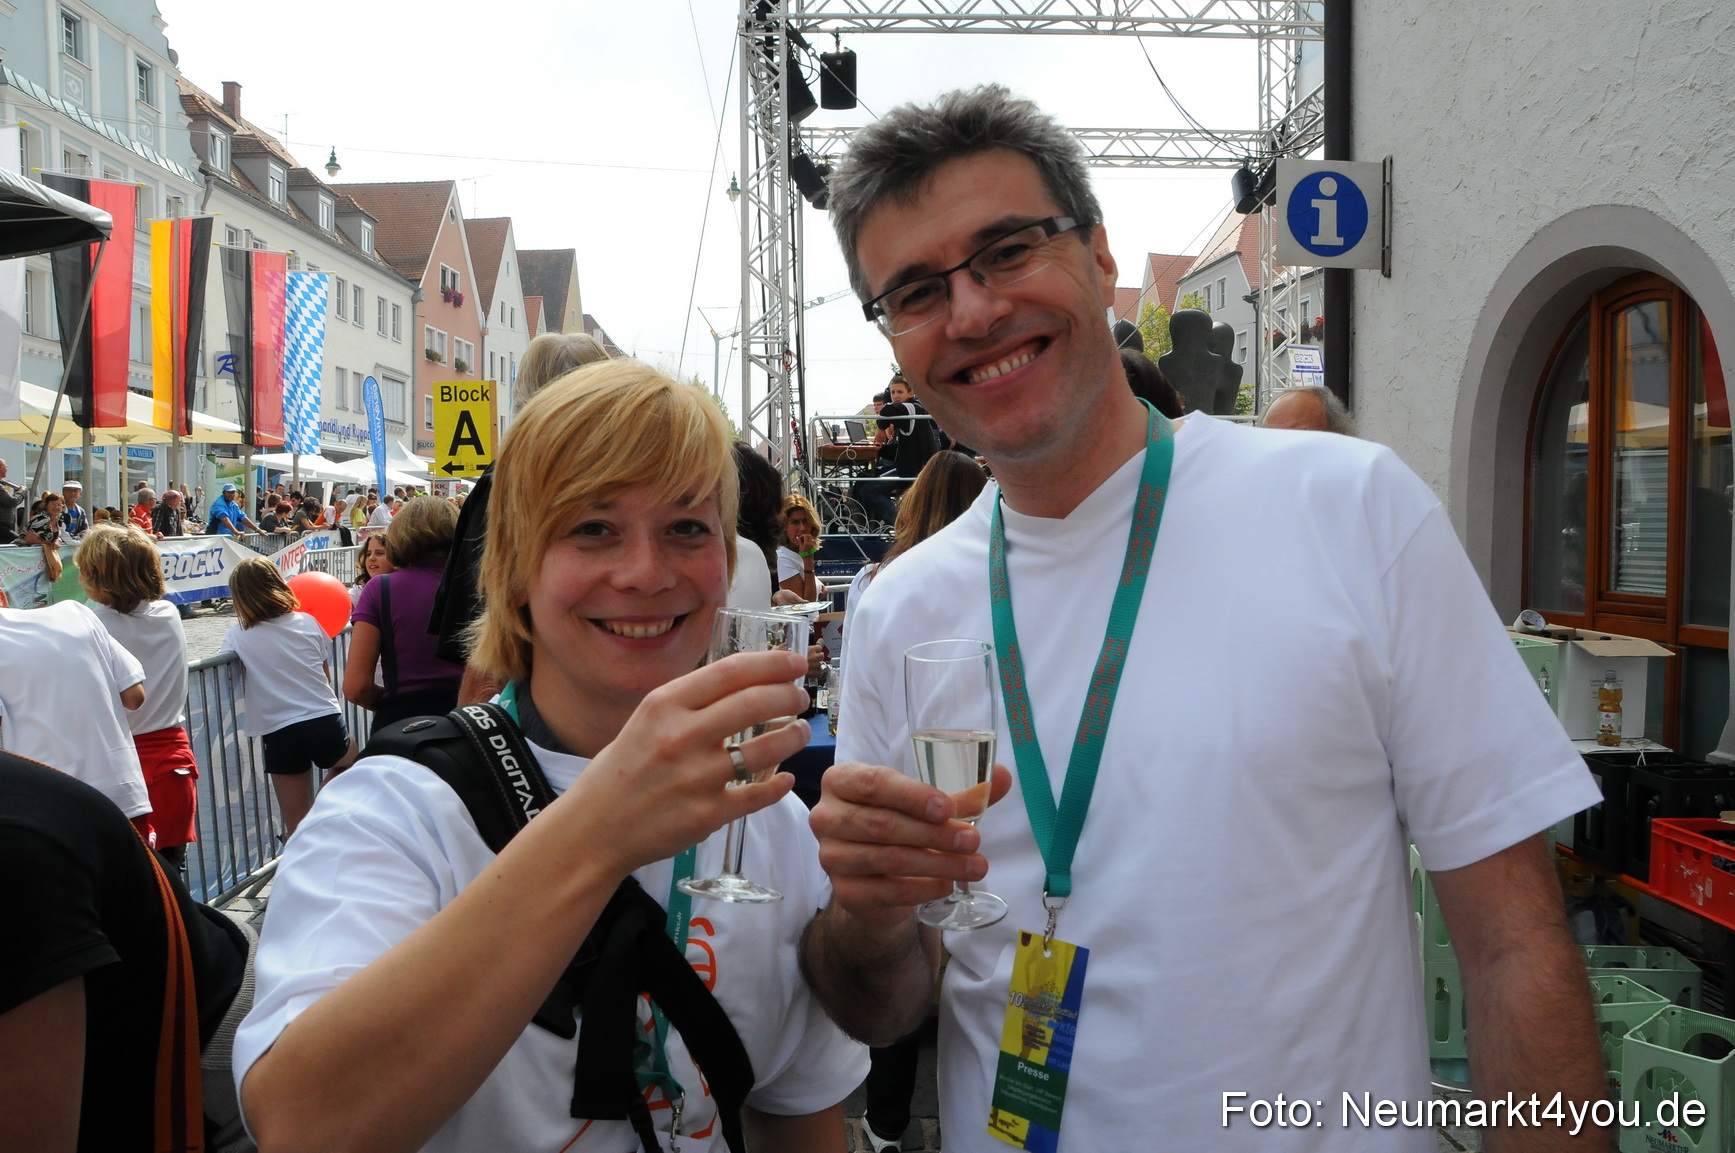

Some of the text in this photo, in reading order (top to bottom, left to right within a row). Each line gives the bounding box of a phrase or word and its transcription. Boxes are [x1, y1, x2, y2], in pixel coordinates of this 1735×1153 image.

[1294, 353, 1314, 364] BOCK
[440, 385, 490, 402] Block
[448, 410, 485, 456] A
[161, 548, 224, 581] BOCK
[462, 706, 540, 822] EOS DIGITAL
[1017, 1061, 1050, 1081] Presse
[1646, 1134, 1690, 1153] NEUMARKTER
